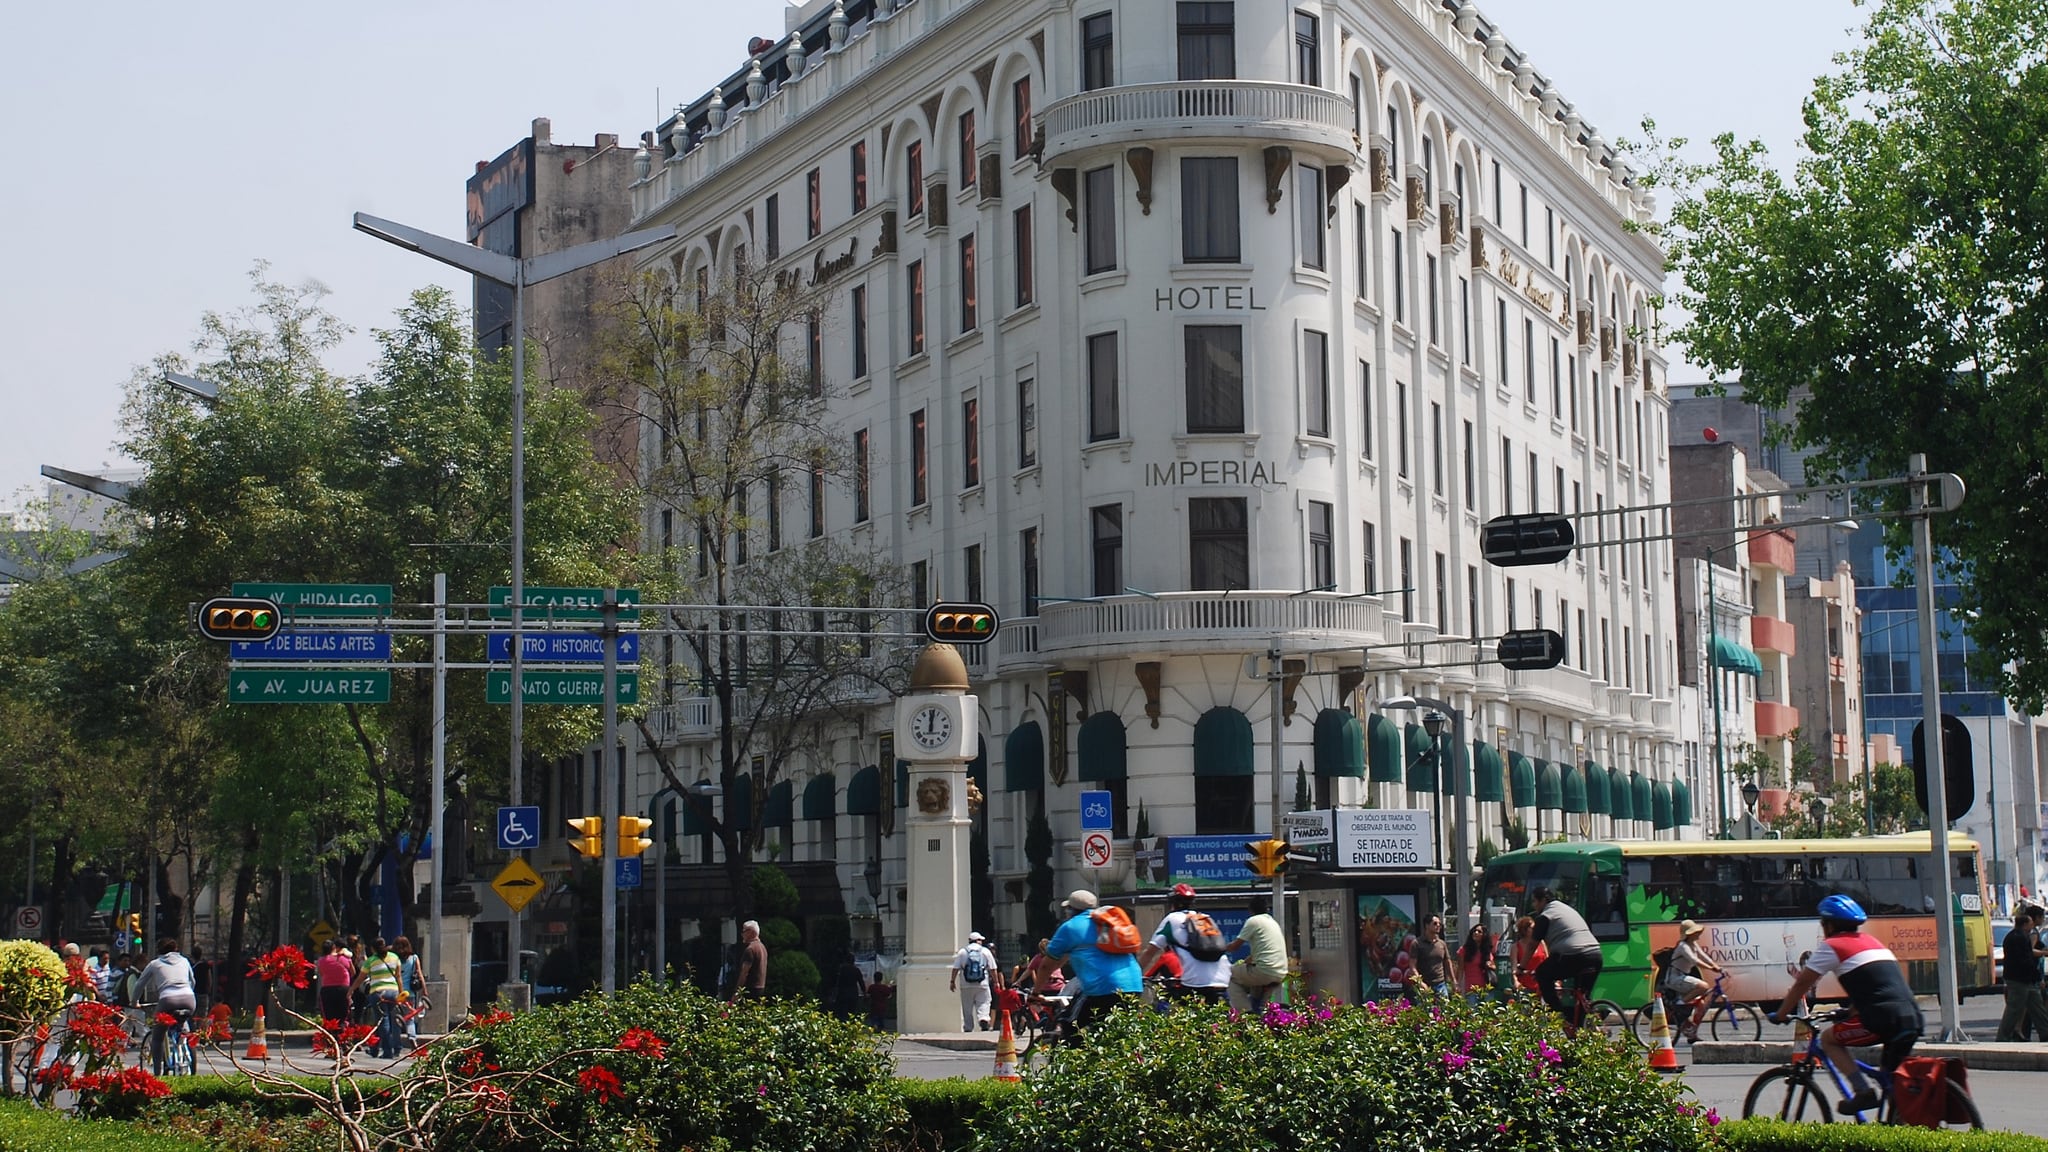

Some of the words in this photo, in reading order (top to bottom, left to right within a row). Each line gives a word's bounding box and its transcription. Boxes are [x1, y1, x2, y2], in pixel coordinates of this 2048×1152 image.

[1155, 286, 1267, 311] HOTEL
[1145, 460, 1288, 487] IMPERIAL
[300, 592, 377, 606] HIDALGO
[277, 636, 290, 650] DE
[295, 636, 336, 651] BELLAS
[340, 636, 376, 651] ARTES
[503, 637, 546, 652] CTRO
[264, 679, 287, 694] AV.
[298, 679, 375, 694] JUAREZ
[1365, 813, 1380, 821] SÓLO
[1351, 823, 1383, 831] OBSERVAR
[1384, 823, 1391, 831] EL
[1392, 823, 1417, 831] MUNDO
[1357, 838, 1368, 850] SE
[1370, 838, 1397, 850] TRATA
[1400, 838, 1413, 850] DE
[1185, 853, 1216, 863] SILLAS
[1217, 853, 1230, 862] DE
[1352, 852, 1418, 864] ENTENDERLO
[623, 861, 630, 872] E
[1962, 897, 1980, 909] 087
[1892, 925, 1933, 939] Descubre
[1701, 944, 1761, 962] BONAFONT
